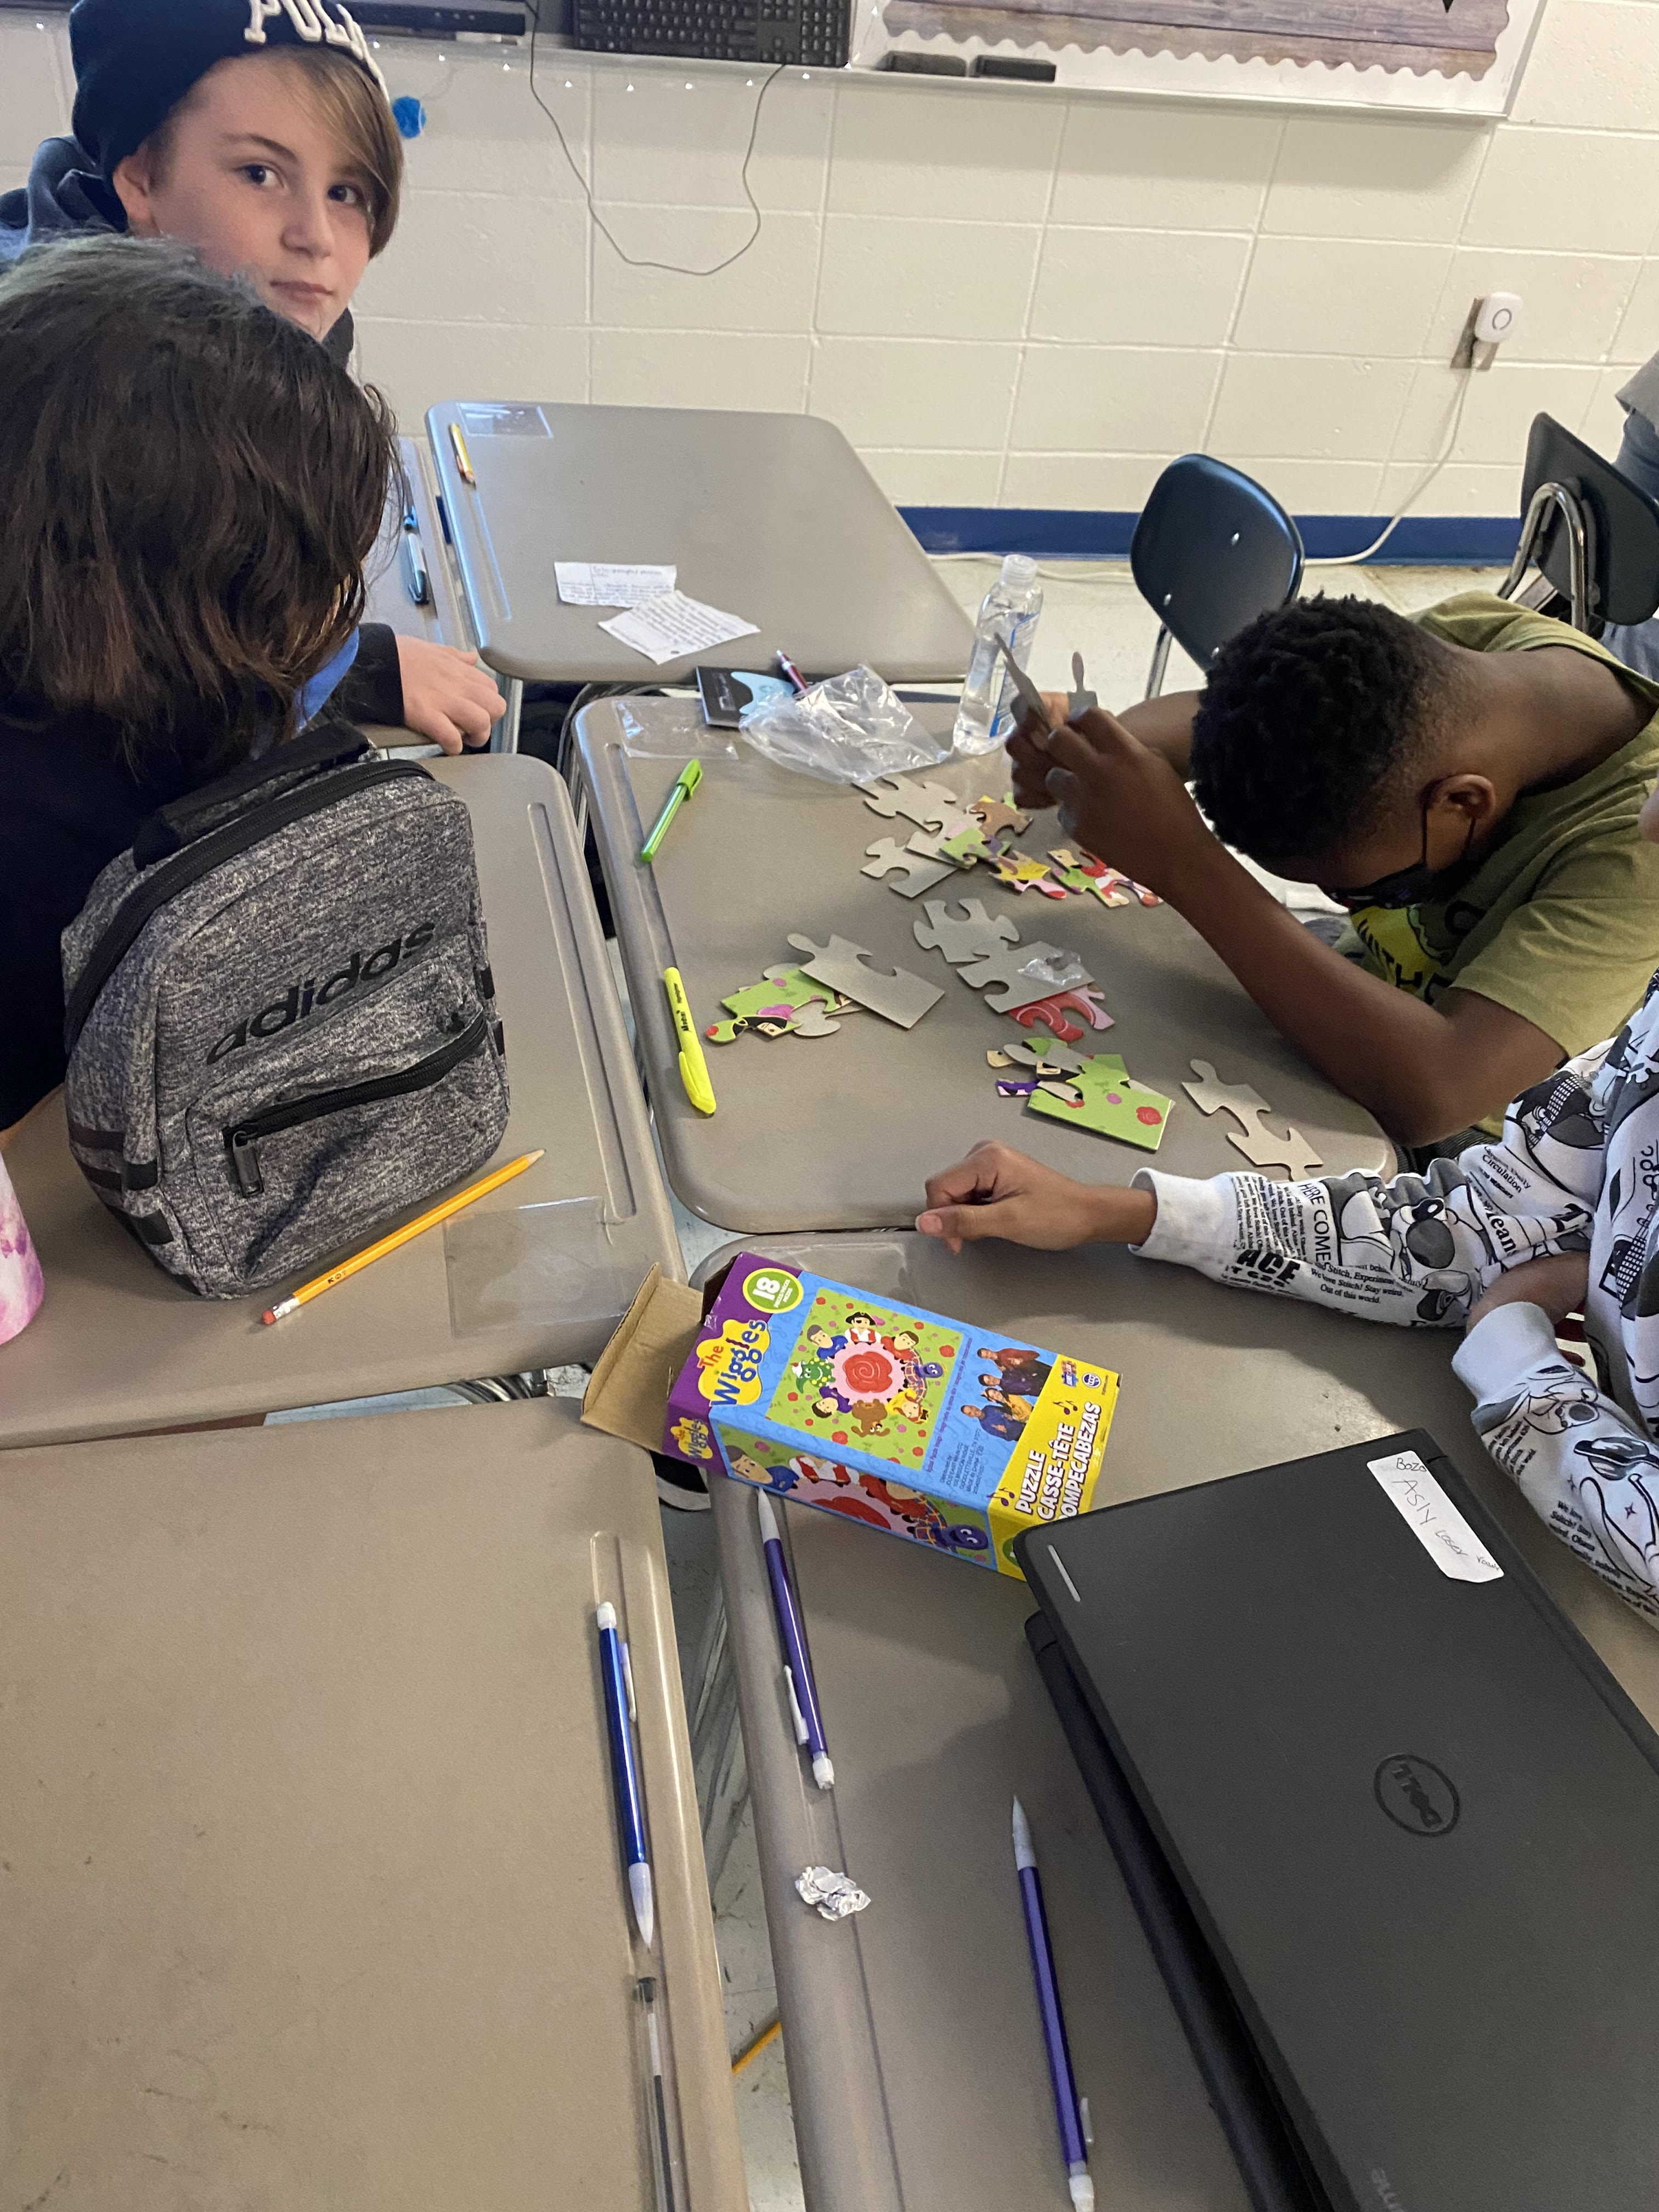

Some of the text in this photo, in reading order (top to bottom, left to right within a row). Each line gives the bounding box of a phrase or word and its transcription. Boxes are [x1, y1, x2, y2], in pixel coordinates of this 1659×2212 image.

[206, 922, 435, 1065] adidas
[1297, 1183, 1325, 1204] HERE
[1482, 1154, 1522, 1193] Circulation
[752, 1277, 780, 1301] 18
[1321, 1284, 1333, 1294] Out
[1334, 1288, 1342, 1296] of
[1344, 1290, 1356, 1300] this
[697, 1345, 724, 1368] The
[709, 1319, 766, 1406] Wiggles
[1015, 1450, 1046, 1515] PUZZLE
[1037, 1422, 1075, 1520] CASSE-TÊTE
[1394, 1763, 1443, 1829] DELL
